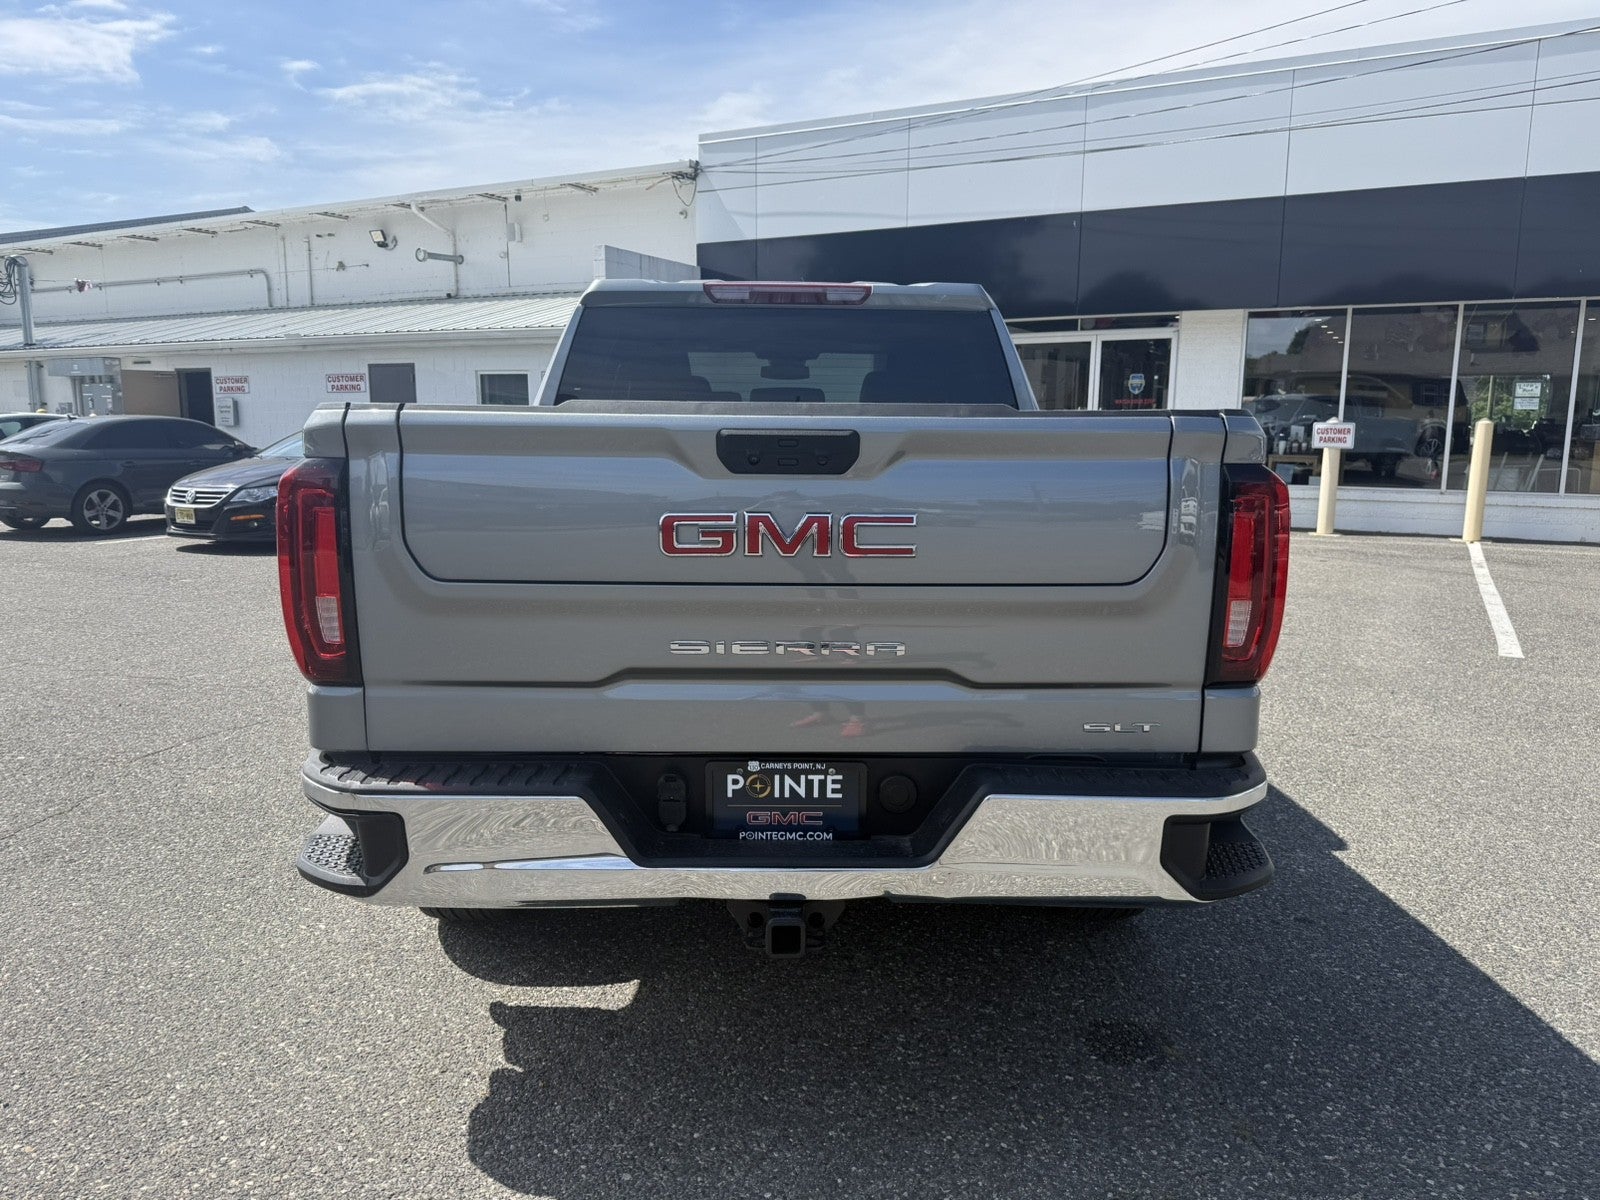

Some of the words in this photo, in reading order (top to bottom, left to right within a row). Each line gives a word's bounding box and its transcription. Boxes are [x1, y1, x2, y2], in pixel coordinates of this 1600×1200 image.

[219, 385, 246, 393] PARKING
[659, 511, 918, 558] GMC
[670, 640, 906, 655] SIERRA
[1083, 722, 1161, 733] SLT
[746, 812, 823, 825] GMC
[739, 832, 832, 840] POINTEGMC.COM
